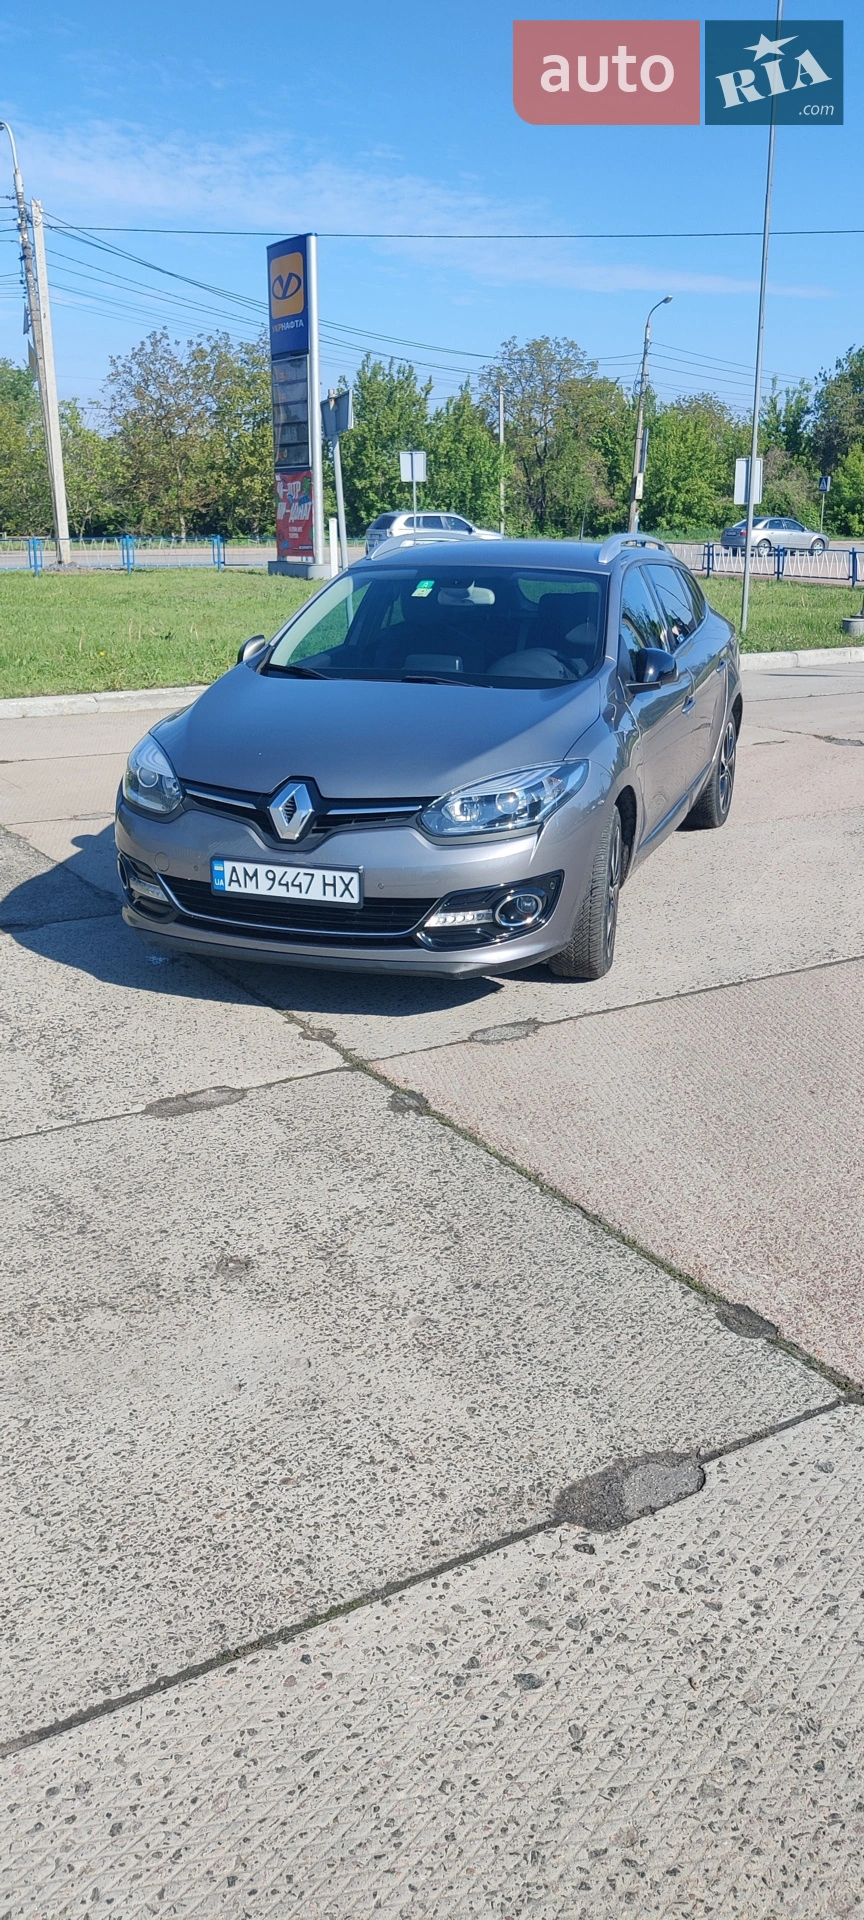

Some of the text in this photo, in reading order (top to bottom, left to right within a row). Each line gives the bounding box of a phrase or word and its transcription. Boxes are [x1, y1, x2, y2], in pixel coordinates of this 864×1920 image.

[214, 878, 225, 887] UA
[228, 866, 355, 899] AM 9447 HX
